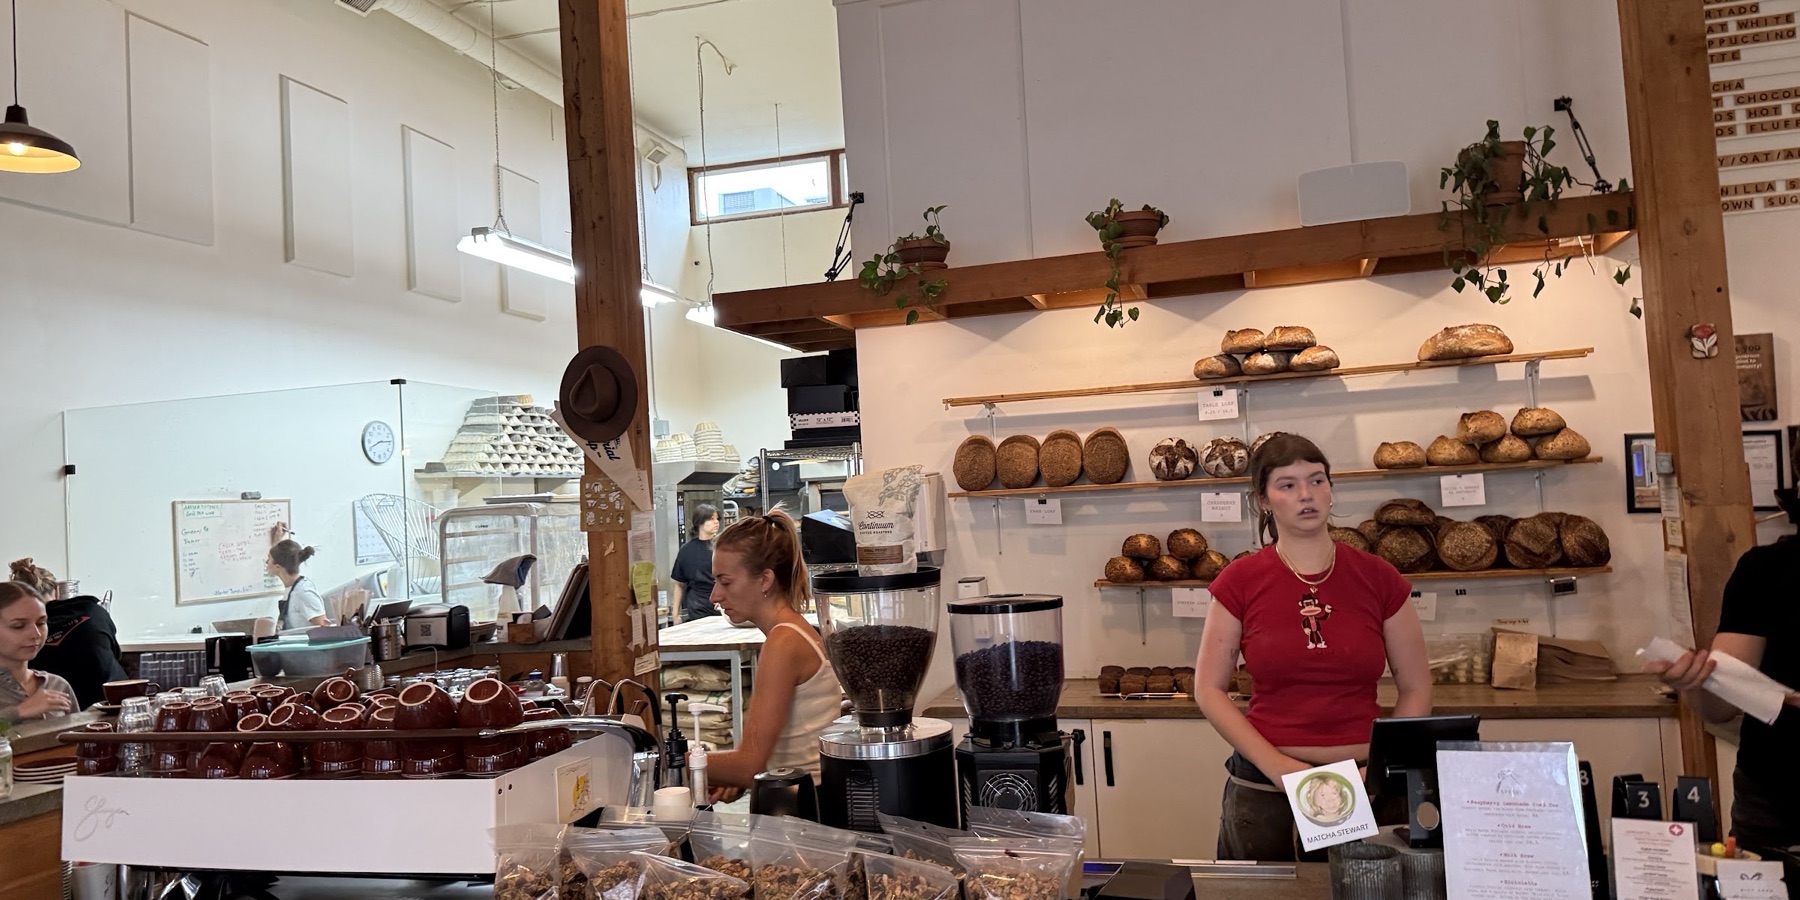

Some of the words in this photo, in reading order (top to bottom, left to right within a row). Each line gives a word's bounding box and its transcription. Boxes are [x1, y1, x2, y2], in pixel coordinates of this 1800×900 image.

[1705, 5, 1758, 18] RTADO
[1706, 23, 1727, 34] AT
[1737, 14, 1792, 29] WHITE
[1707, 29, 1796, 49] PPUCCINO
[1709, 51, 1740, 63] TTE
[1711, 81, 1743, 92] CHA
[1736, 89, 1800, 104] CHOCOL
[1748, 106, 1780, 118] HOT
[1720, 182, 1775, 196] NILLA
[1721, 200, 1753, 211] OWN
[1767, 195, 1799, 206] SUG
[858, 521, 894, 531] Continuum
[1637, 790, 1650, 808] 3
[1687, 785, 1701, 803] 4
[1470, 799, 1500, 807] Raspberry
[1306, 831, 1337, 844] MATCHA
[1336, 823, 1369, 837] STEWART
